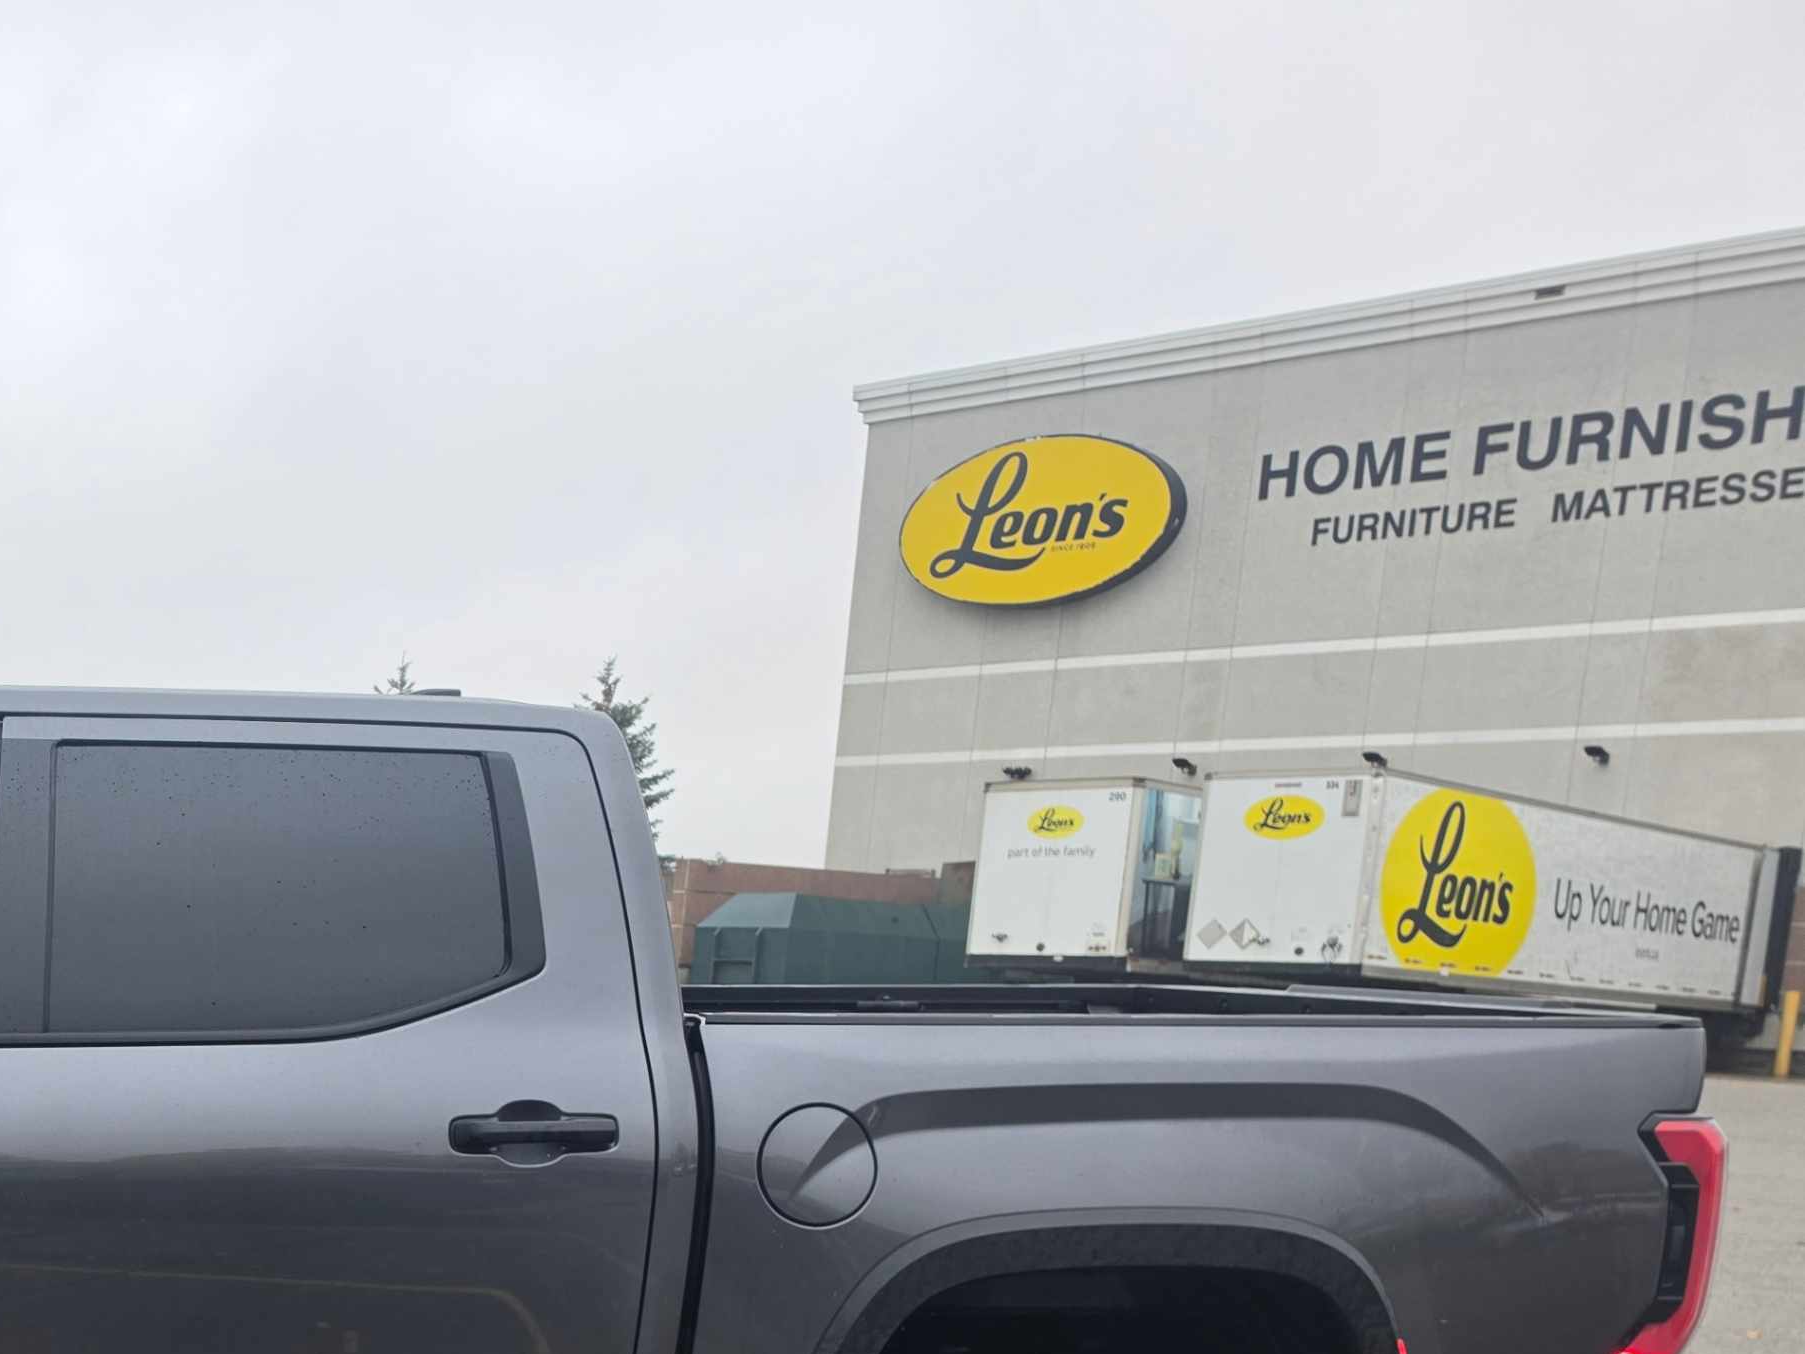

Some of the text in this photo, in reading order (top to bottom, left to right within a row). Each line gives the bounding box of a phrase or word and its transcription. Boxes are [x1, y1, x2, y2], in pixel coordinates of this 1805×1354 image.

[1258, 384, 1805, 501] HOME FURNISH
[929, 451, 1129, 578] Leon's
[1310, 466, 1805, 547] FURNITURE MATTRESSE
[1396, 799, 1514, 948] Leon's
[1554, 877, 1740, 944] Up Your Home Game
